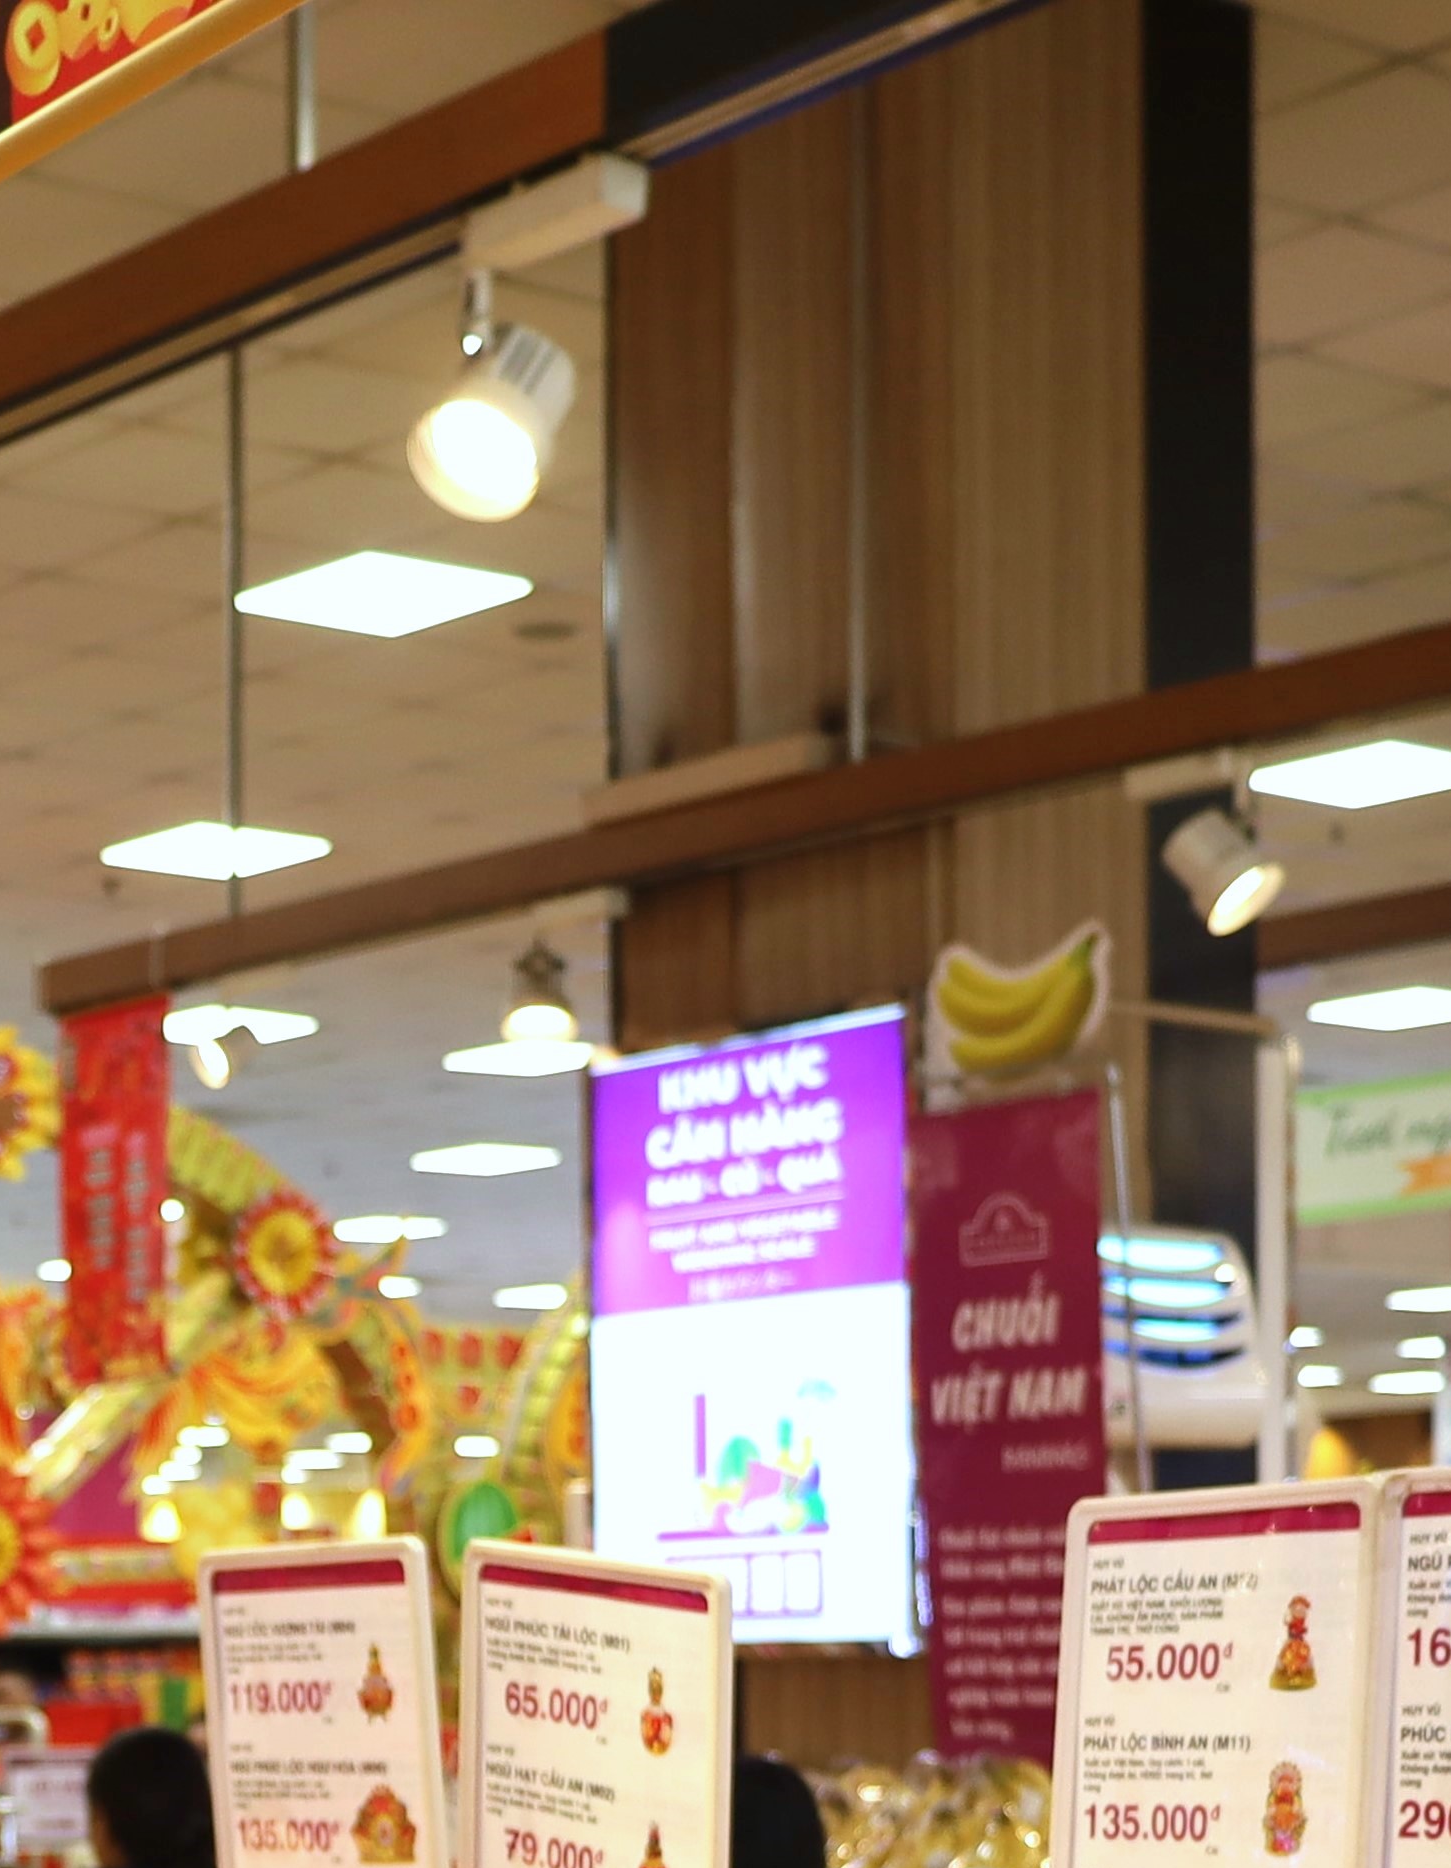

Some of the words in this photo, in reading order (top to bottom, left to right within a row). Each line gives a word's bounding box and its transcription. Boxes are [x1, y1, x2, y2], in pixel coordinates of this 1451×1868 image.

[950, 1270, 1062, 1353] CHUỐI
[931, 1362, 1004, 1434] VIỆT
[1008, 1367, 1088, 1421] NAM
[1199, 1575, 1217, 1589] AN
[1400, 1723, 1446, 1743] PHÚC
[1188, 1735, 1208, 1750] AN
[1213, 1735, 1251, 1753] (M11)
[567, 1778, 583, 1792] AN
